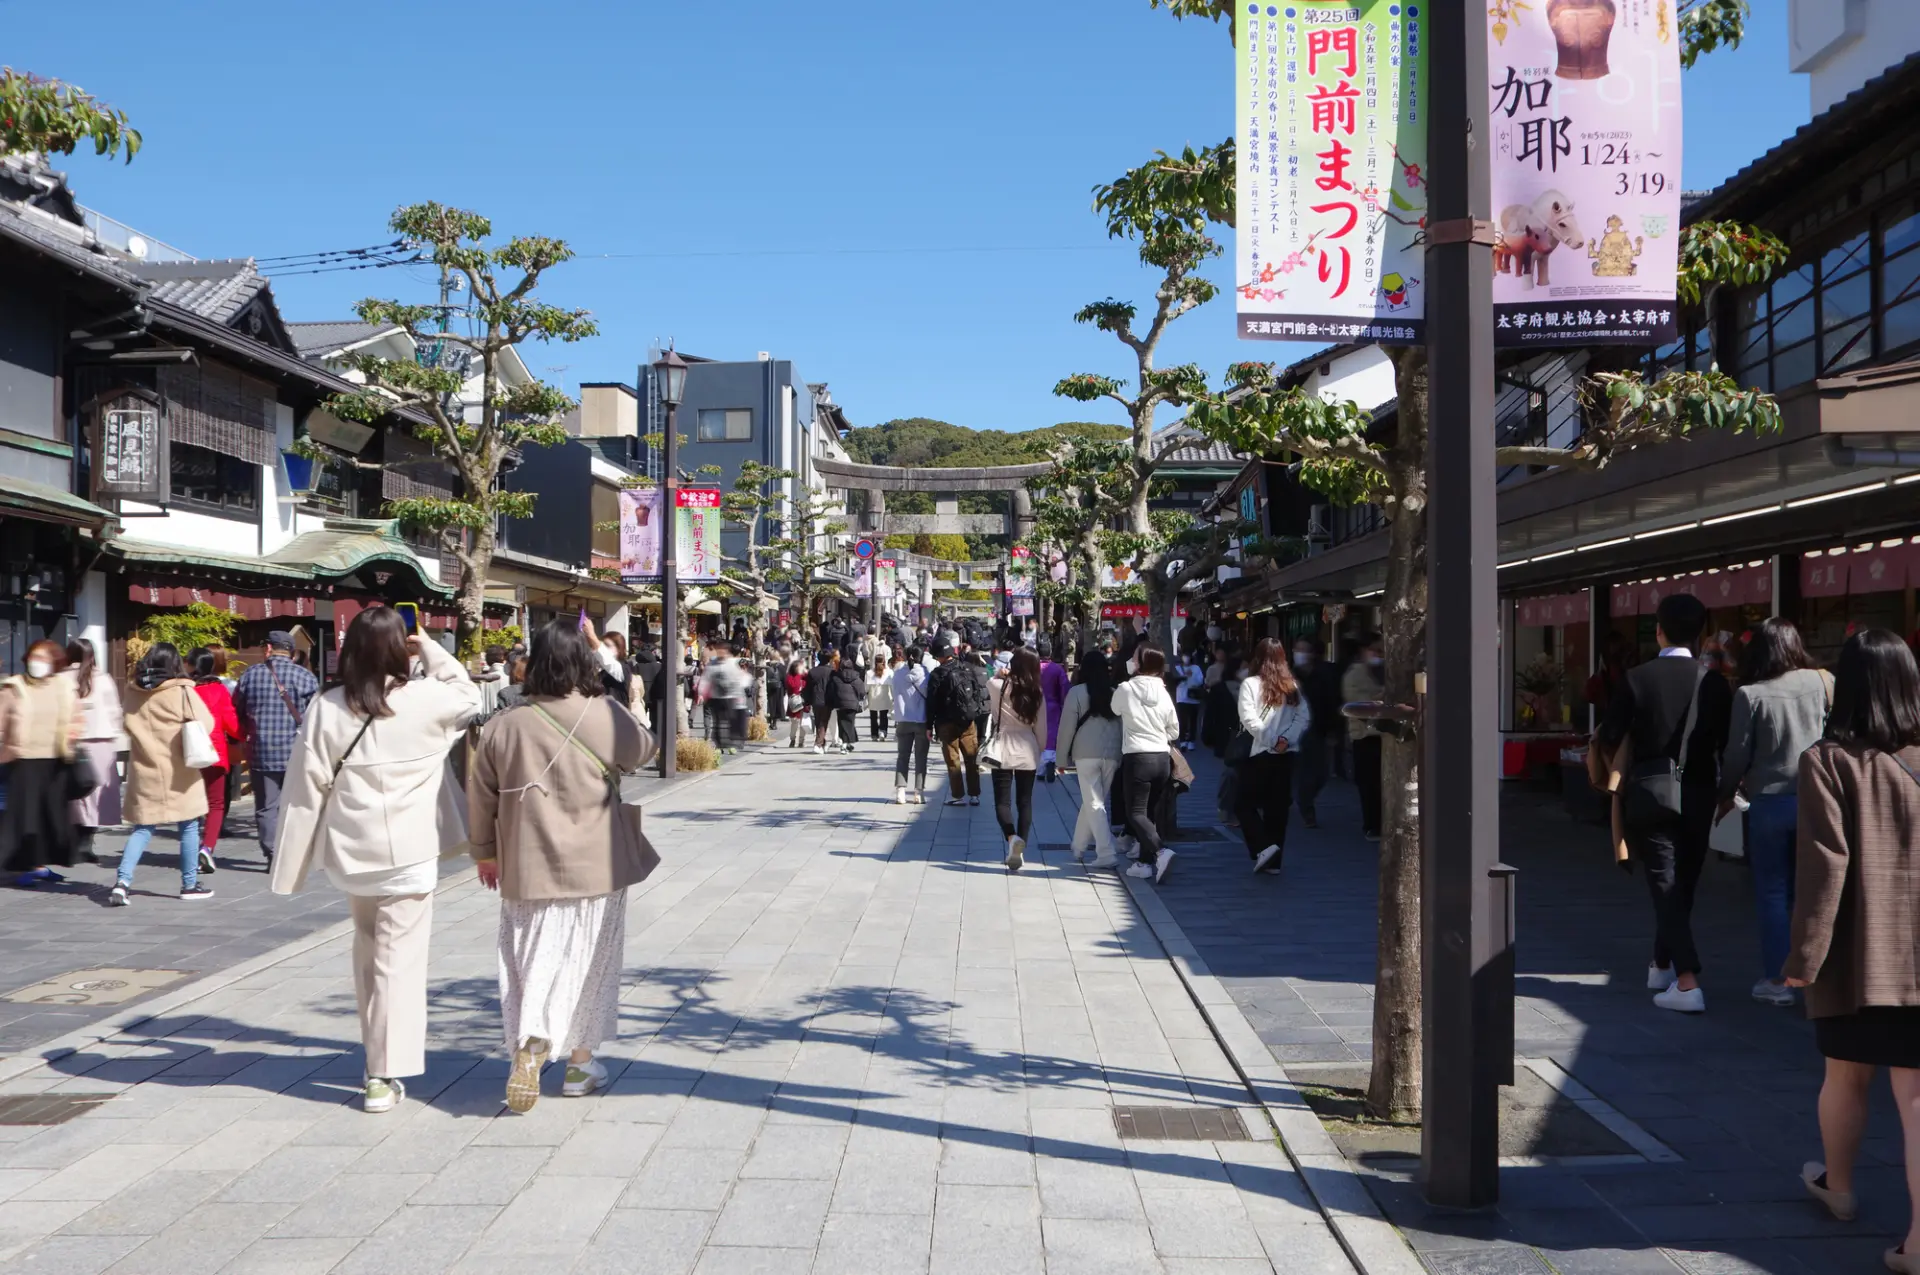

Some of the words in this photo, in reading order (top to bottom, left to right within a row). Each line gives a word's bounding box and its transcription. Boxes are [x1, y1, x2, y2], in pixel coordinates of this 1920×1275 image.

[1304, 8, 1360, 24] 第25回
[1286, 22, 1298, 57] 梅上げ
[1390, 21, 1401, 67] 曲水の宴
[1407, 22, 1419, 57] 献華祭
[1248, 19, 1260, 111] 門前まつりフェア
[1286, 60, 1298, 84] 還暦
[1490, 65, 1573, 174] 加耶
[1248, 116, 1260, 174] 天満宮境内
[1499, 131, 1510, 154] かや
[1287, 154, 1299, 178] 初老
[1305, 27, 1361, 299] 門前まつり
[1496, 308, 1672, 329] 太宰府観光協会・太宰府市
[120, 421, 143, 475] 風見鶏
[692, 513, 704, 576] 門前まつり
